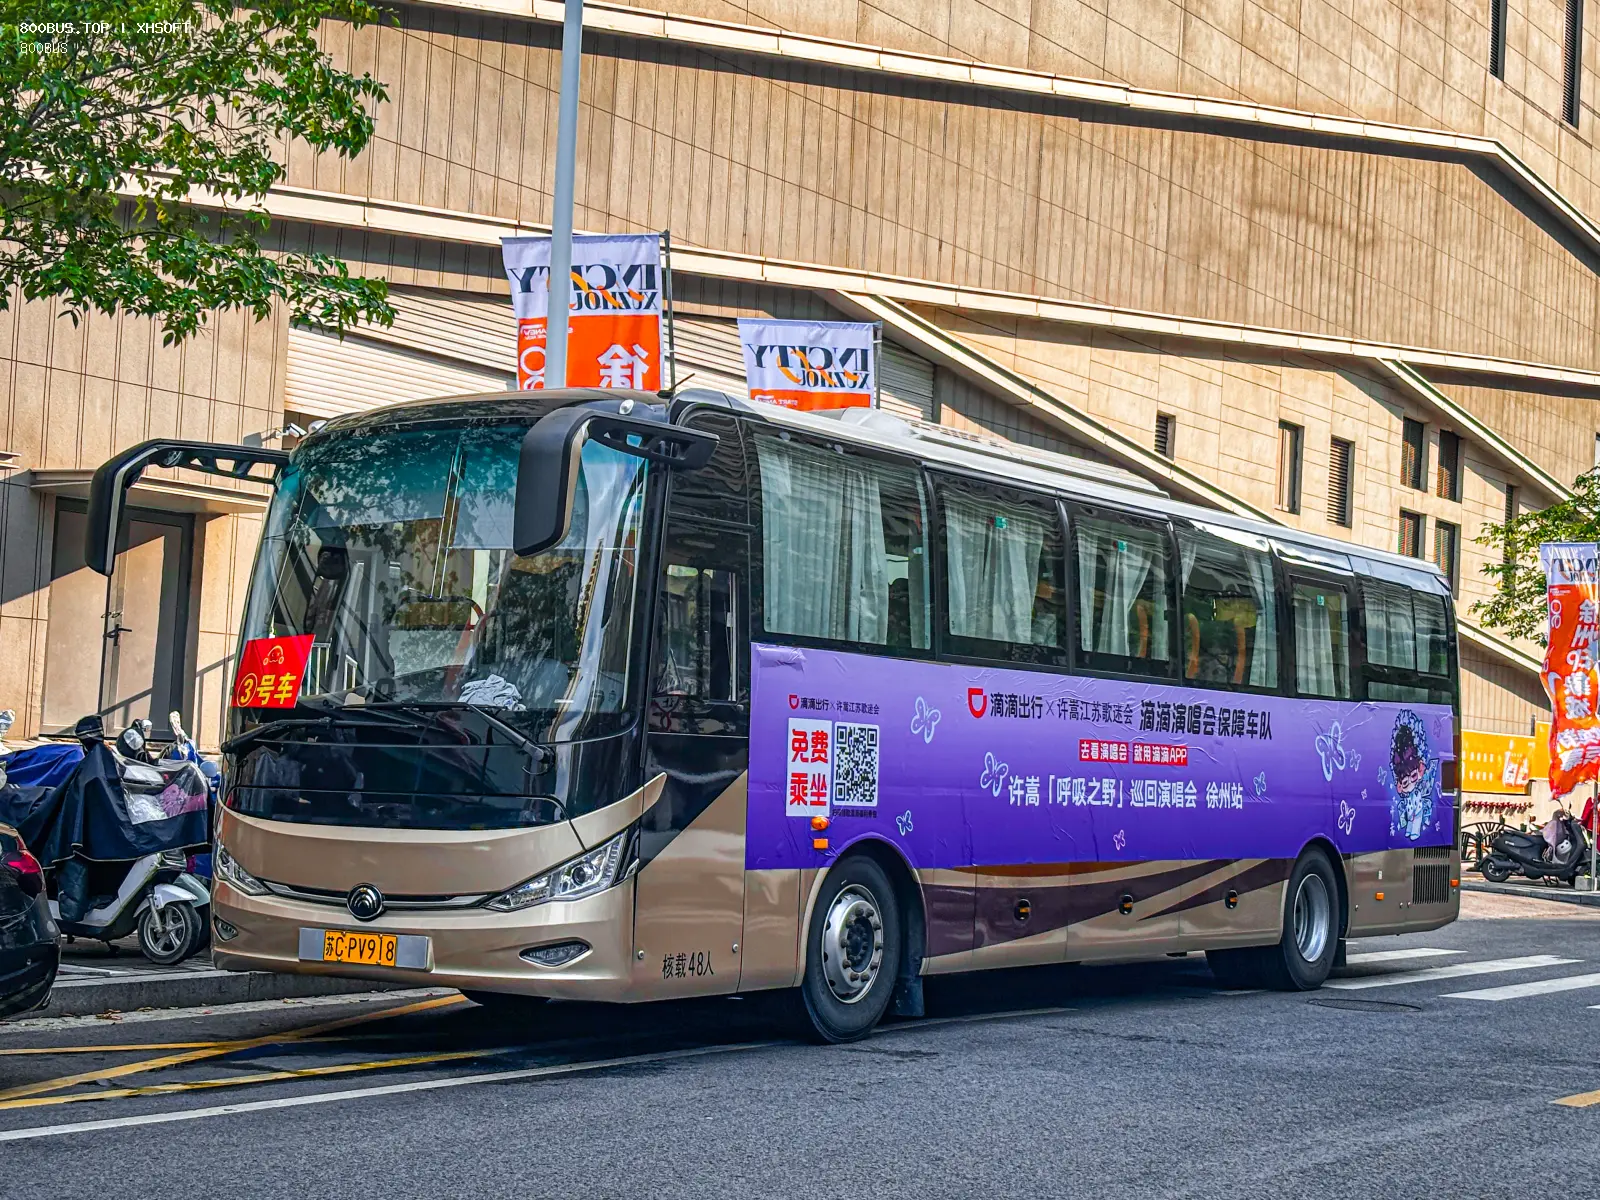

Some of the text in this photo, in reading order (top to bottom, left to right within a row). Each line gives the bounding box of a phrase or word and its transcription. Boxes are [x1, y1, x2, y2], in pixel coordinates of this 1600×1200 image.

[1139, 699, 1273, 740] 滴滴演唱会保障车队
[791, 728, 829, 764] 免费
[789, 772, 828, 807] 乘坐
[1205, 781, 1244, 810] 徐州站
[662, 950, 715, 980] 核载48人
